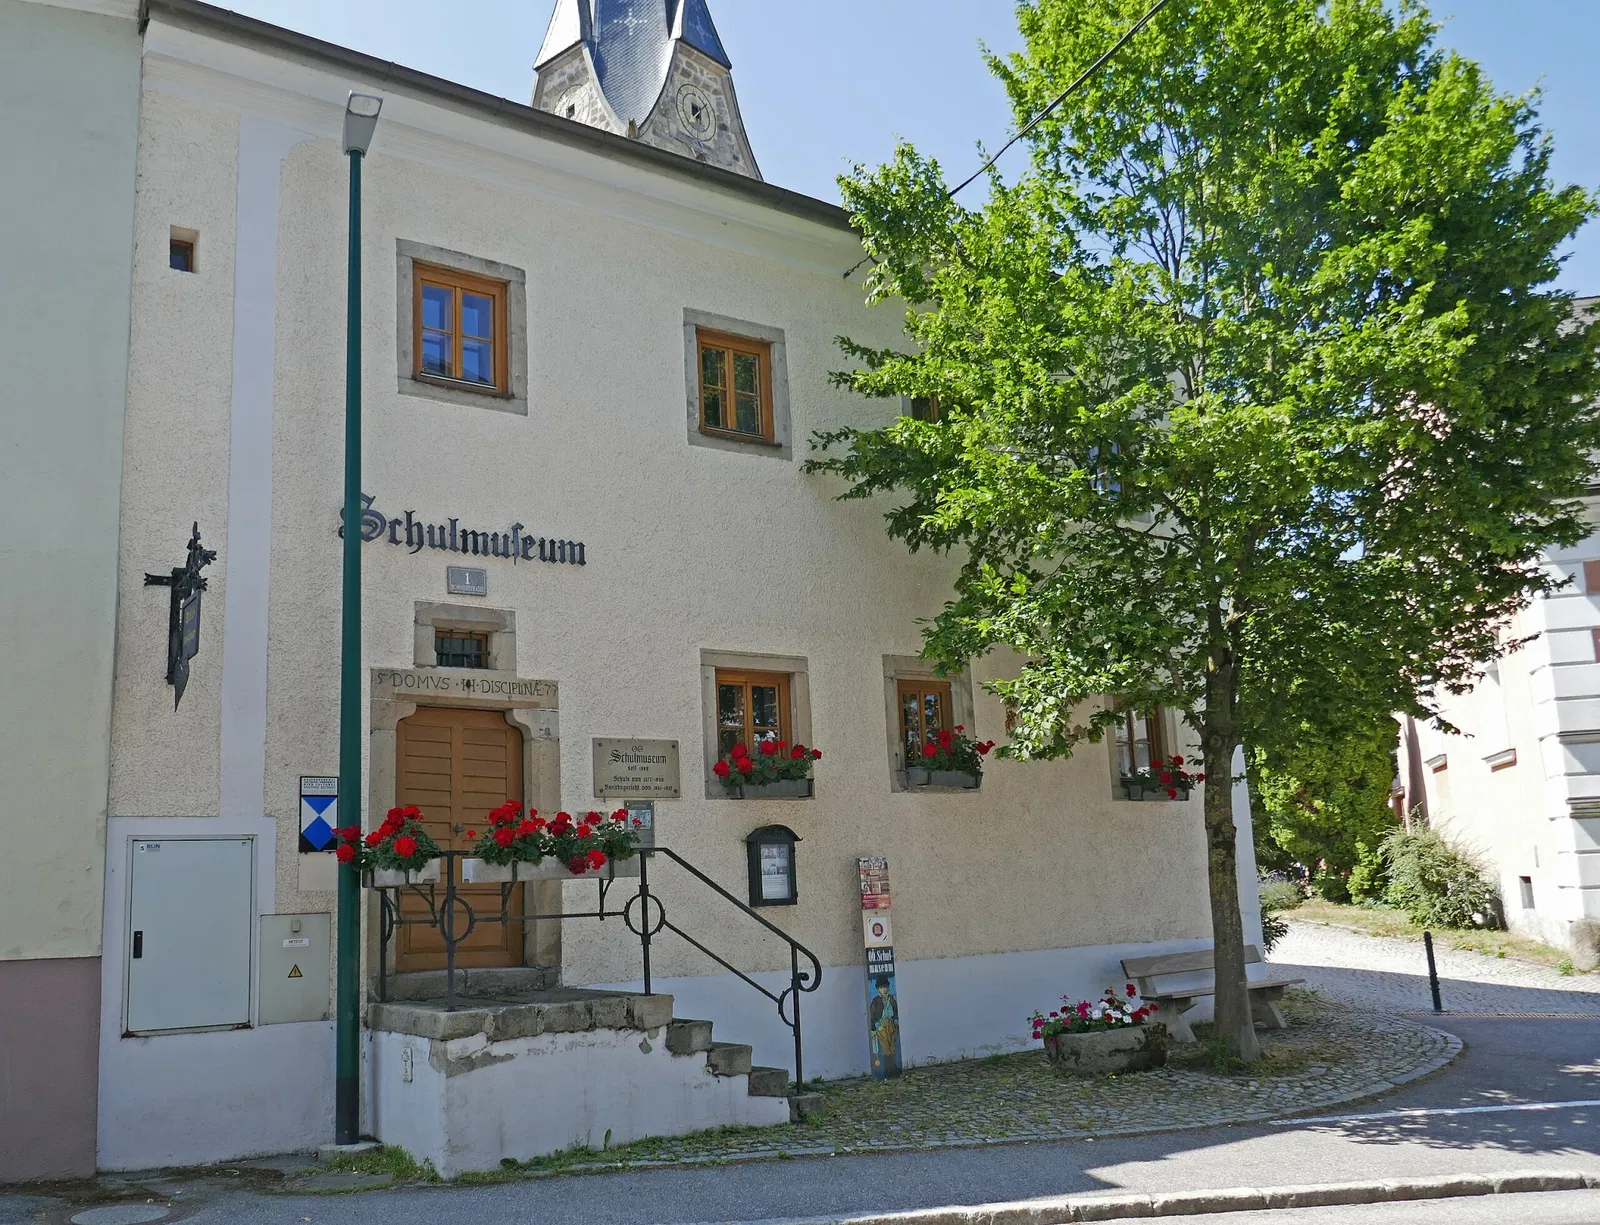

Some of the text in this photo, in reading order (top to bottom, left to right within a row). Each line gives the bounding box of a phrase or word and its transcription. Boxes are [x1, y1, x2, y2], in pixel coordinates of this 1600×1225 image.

[465, 572, 470, 585] 1
[390, 672, 451, 690] DOMVS
[608, 749, 667, 765] Schulmuseum
[868, 963, 894, 974] museum
